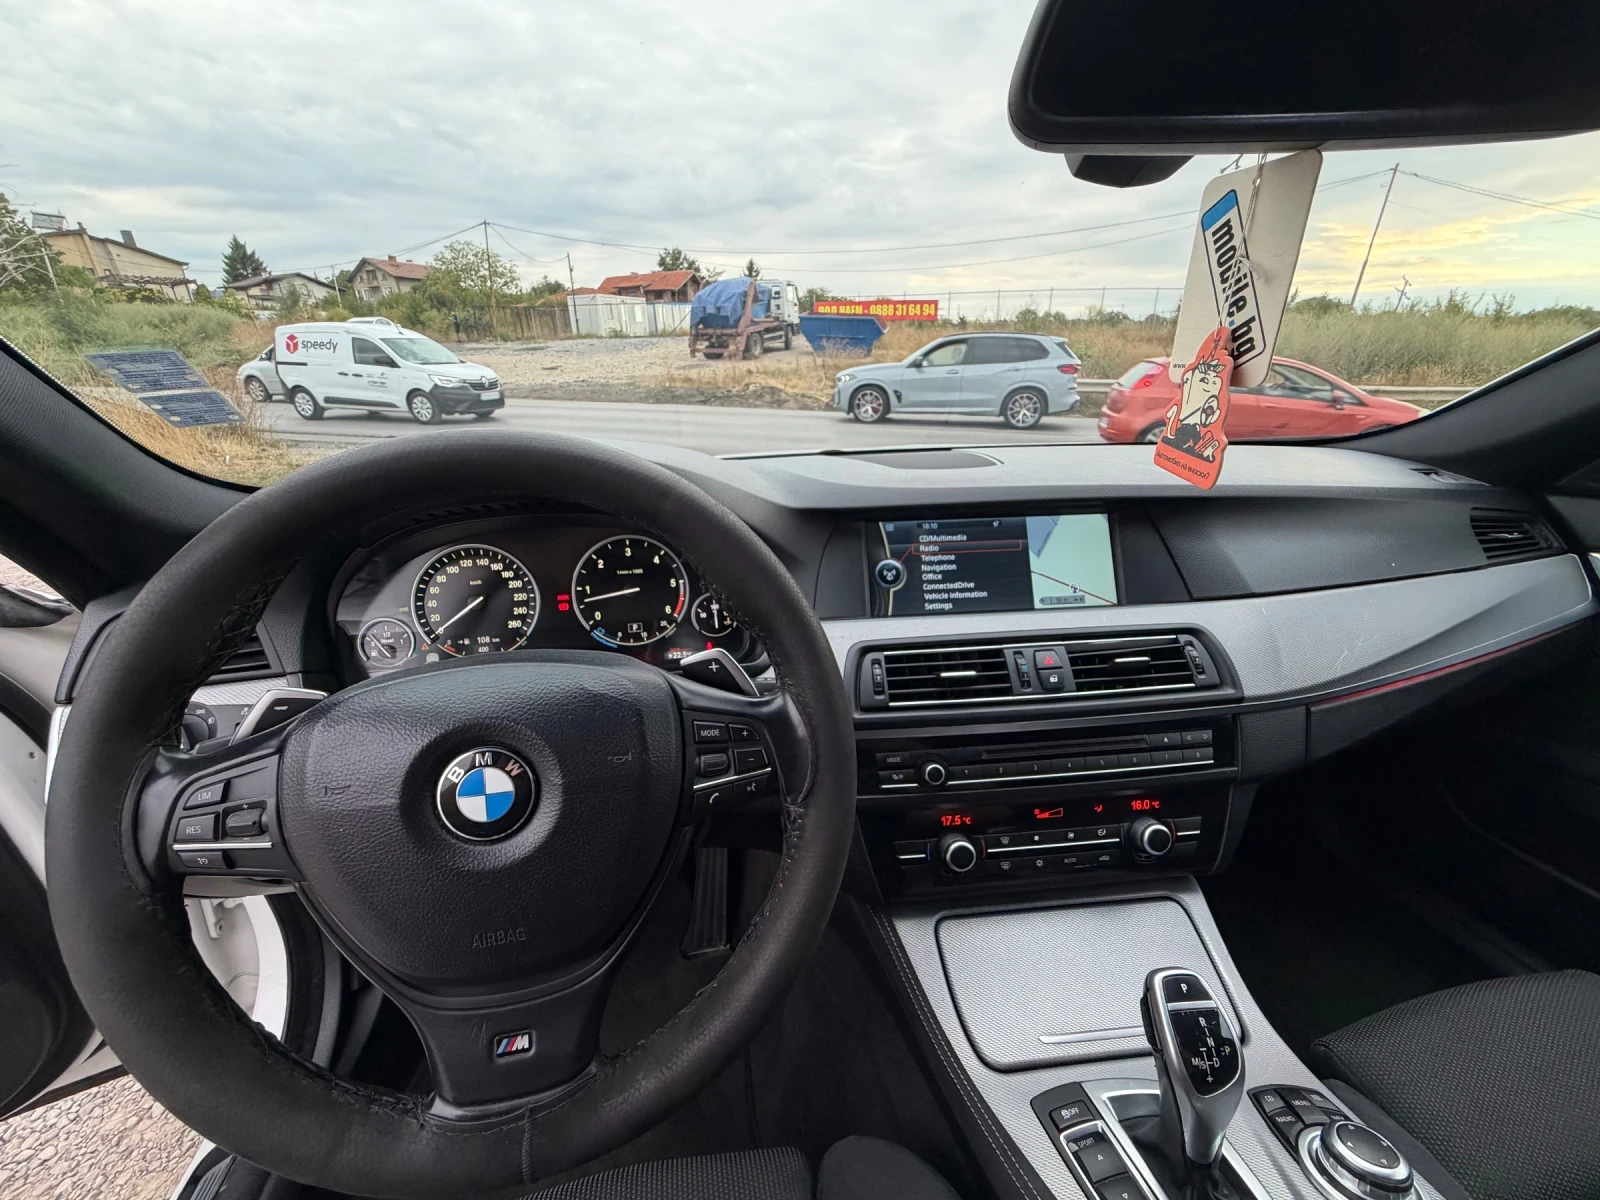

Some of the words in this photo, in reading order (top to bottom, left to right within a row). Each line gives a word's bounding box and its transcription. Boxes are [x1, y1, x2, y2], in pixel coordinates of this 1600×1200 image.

[896, 304, 907, 316] 31
[909, 304, 920, 316] 64
[922, 304, 935, 316] 94
[301, 338, 339, 353] speedy
[919, 534, 967, 542] CD/Multimedia
[625, 548, 631, 556] 3
[476, 558, 489, 566] 140
[653, 556, 660, 564] 4
[921, 554, 955, 562] Telephone
[459, 559, 472, 567] 120
[490, 563, 503, 571] 160
[598, 560, 604, 568] 2
[446, 566, 459, 574] 100
[922, 563, 956, 572] Navigation
[501, 570, 514, 578] 180
[508, 580, 522, 588] 200
[670, 579, 676, 587] 5
[923, 581, 975, 590] ConnectedDrive
[585, 586, 590, 594] 1
[514, 593, 527, 601] 220
[924, 592, 949, 600] Vehicle
[666, 605, 671, 614] 6
[924, 602, 954, 610] Settings
[514, 607, 527, 615] 240
[430, 614, 440, 622] 20
[595, 612, 601, 620] 0
[508, 620, 522, 628] 260
[477, 636, 490, 644] 108
[700, 728, 721, 737] MODE
[446, 752, 524, 784] BMW
[198, 791, 212, 801] LIM
[1131, 800, 1150, 810] 16.0
[941, 815, 961, 826] 17.5
[186, 825, 202, 834] RES
[472, 928, 526, 949] AIRBAG
[1180, 983, 1188, 994] P
[1198, 1016, 1207, 1027] R
[1206, 1037, 1215, 1048] N
[1225, 1045, 1231, 1055] P
[1213, 1057, 1220, 1068] D
[1068, 1106, 1080, 1116] OFF
[1077, 1137, 1095, 1148] SPORT
